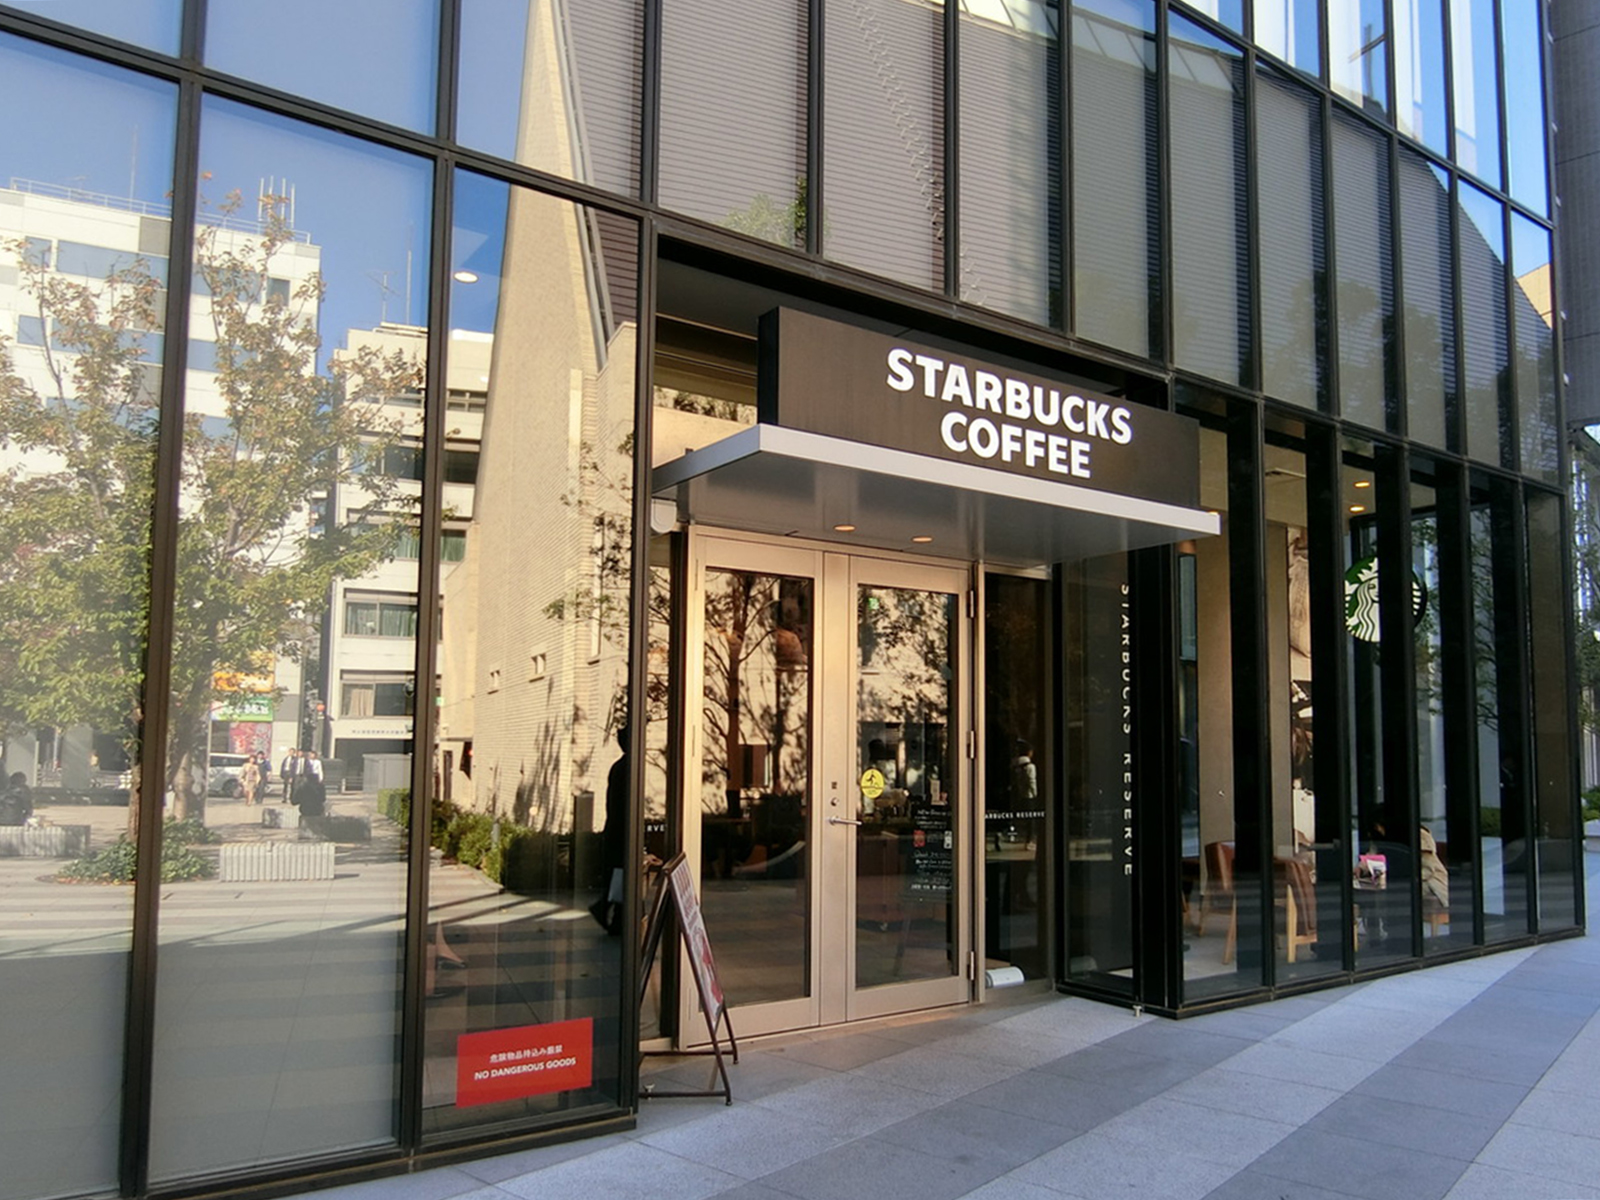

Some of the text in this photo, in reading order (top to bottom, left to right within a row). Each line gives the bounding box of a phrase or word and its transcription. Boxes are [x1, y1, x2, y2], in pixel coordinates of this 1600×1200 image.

[886, 348, 1133, 445] STARBUCKS
[940, 411, 1091, 478] COFFEE
[474, 1056, 576, 1081] NO DANGEROUS GOODS
